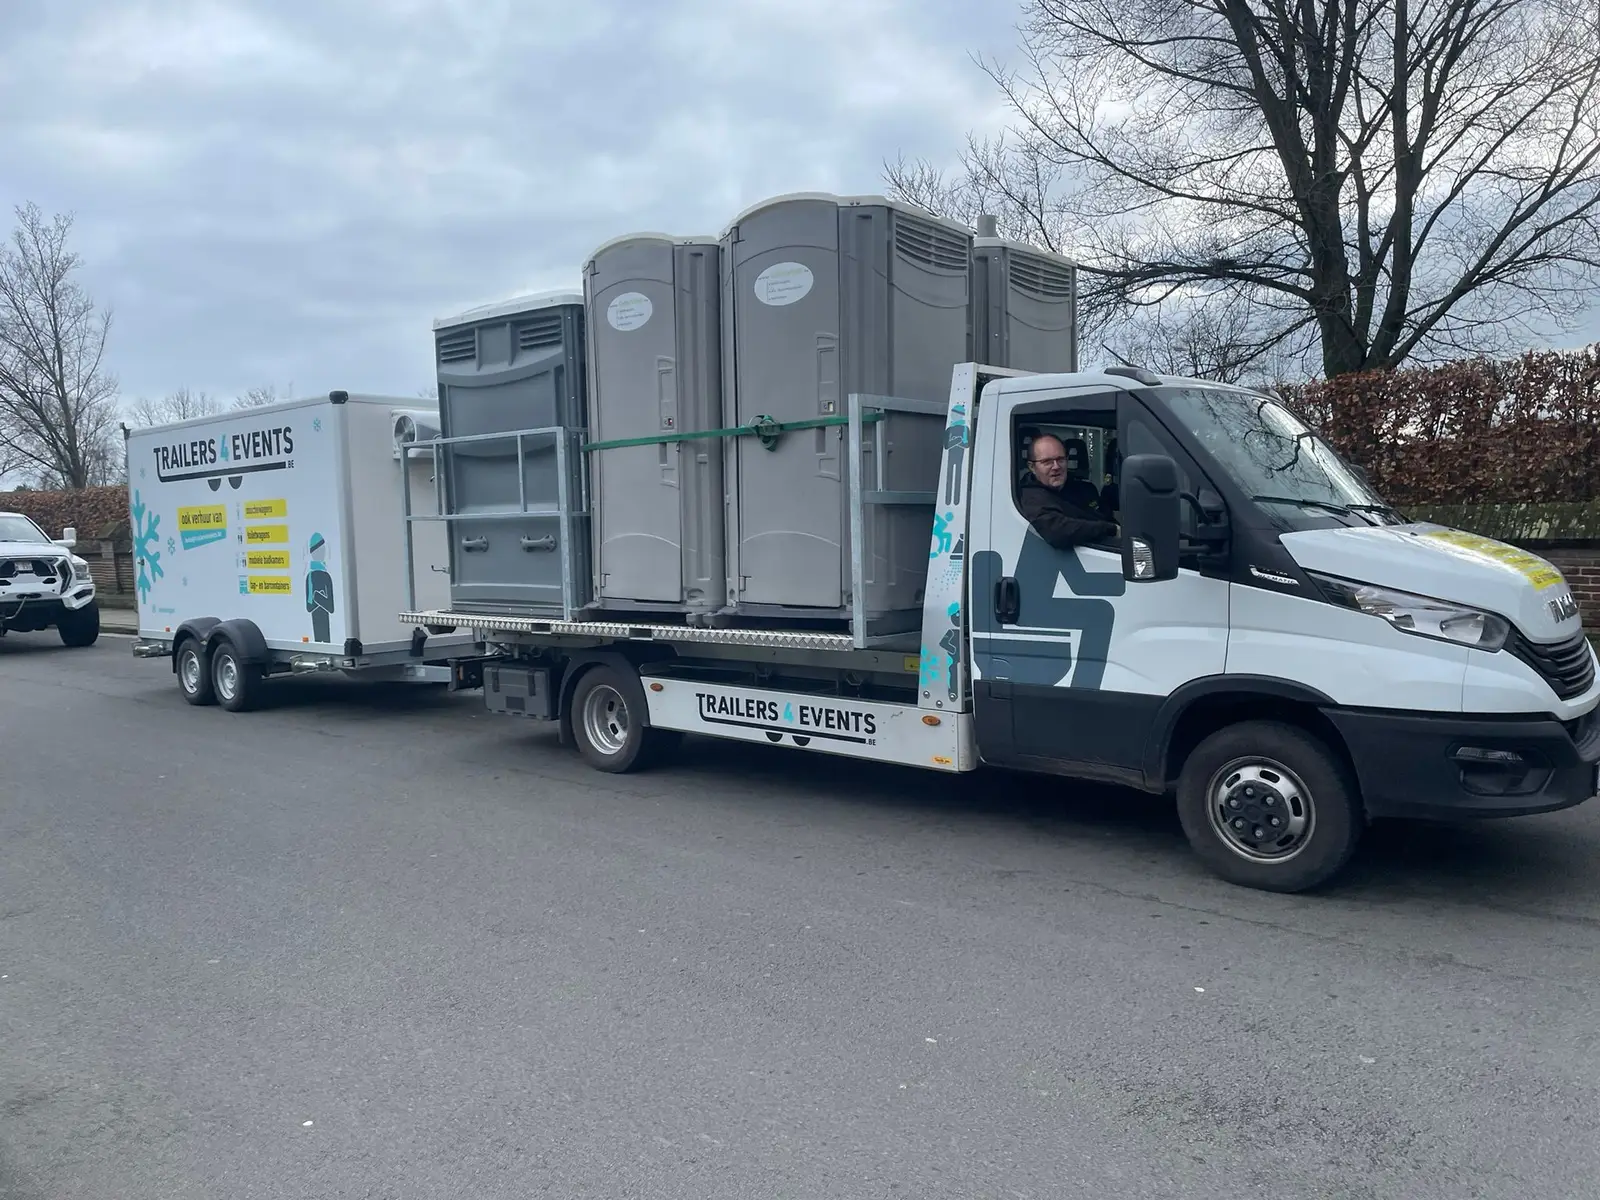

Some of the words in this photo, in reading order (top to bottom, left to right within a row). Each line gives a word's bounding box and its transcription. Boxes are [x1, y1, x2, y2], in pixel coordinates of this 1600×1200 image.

[153, 438, 217, 471] TRAILERS
[220, 433, 229, 462] 4
[232, 426, 294, 461] EVENTS
[695, 693, 779, 722] TRAILERS
[783, 701, 794, 724] 4
[799, 705, 876, 735] EVENTS
